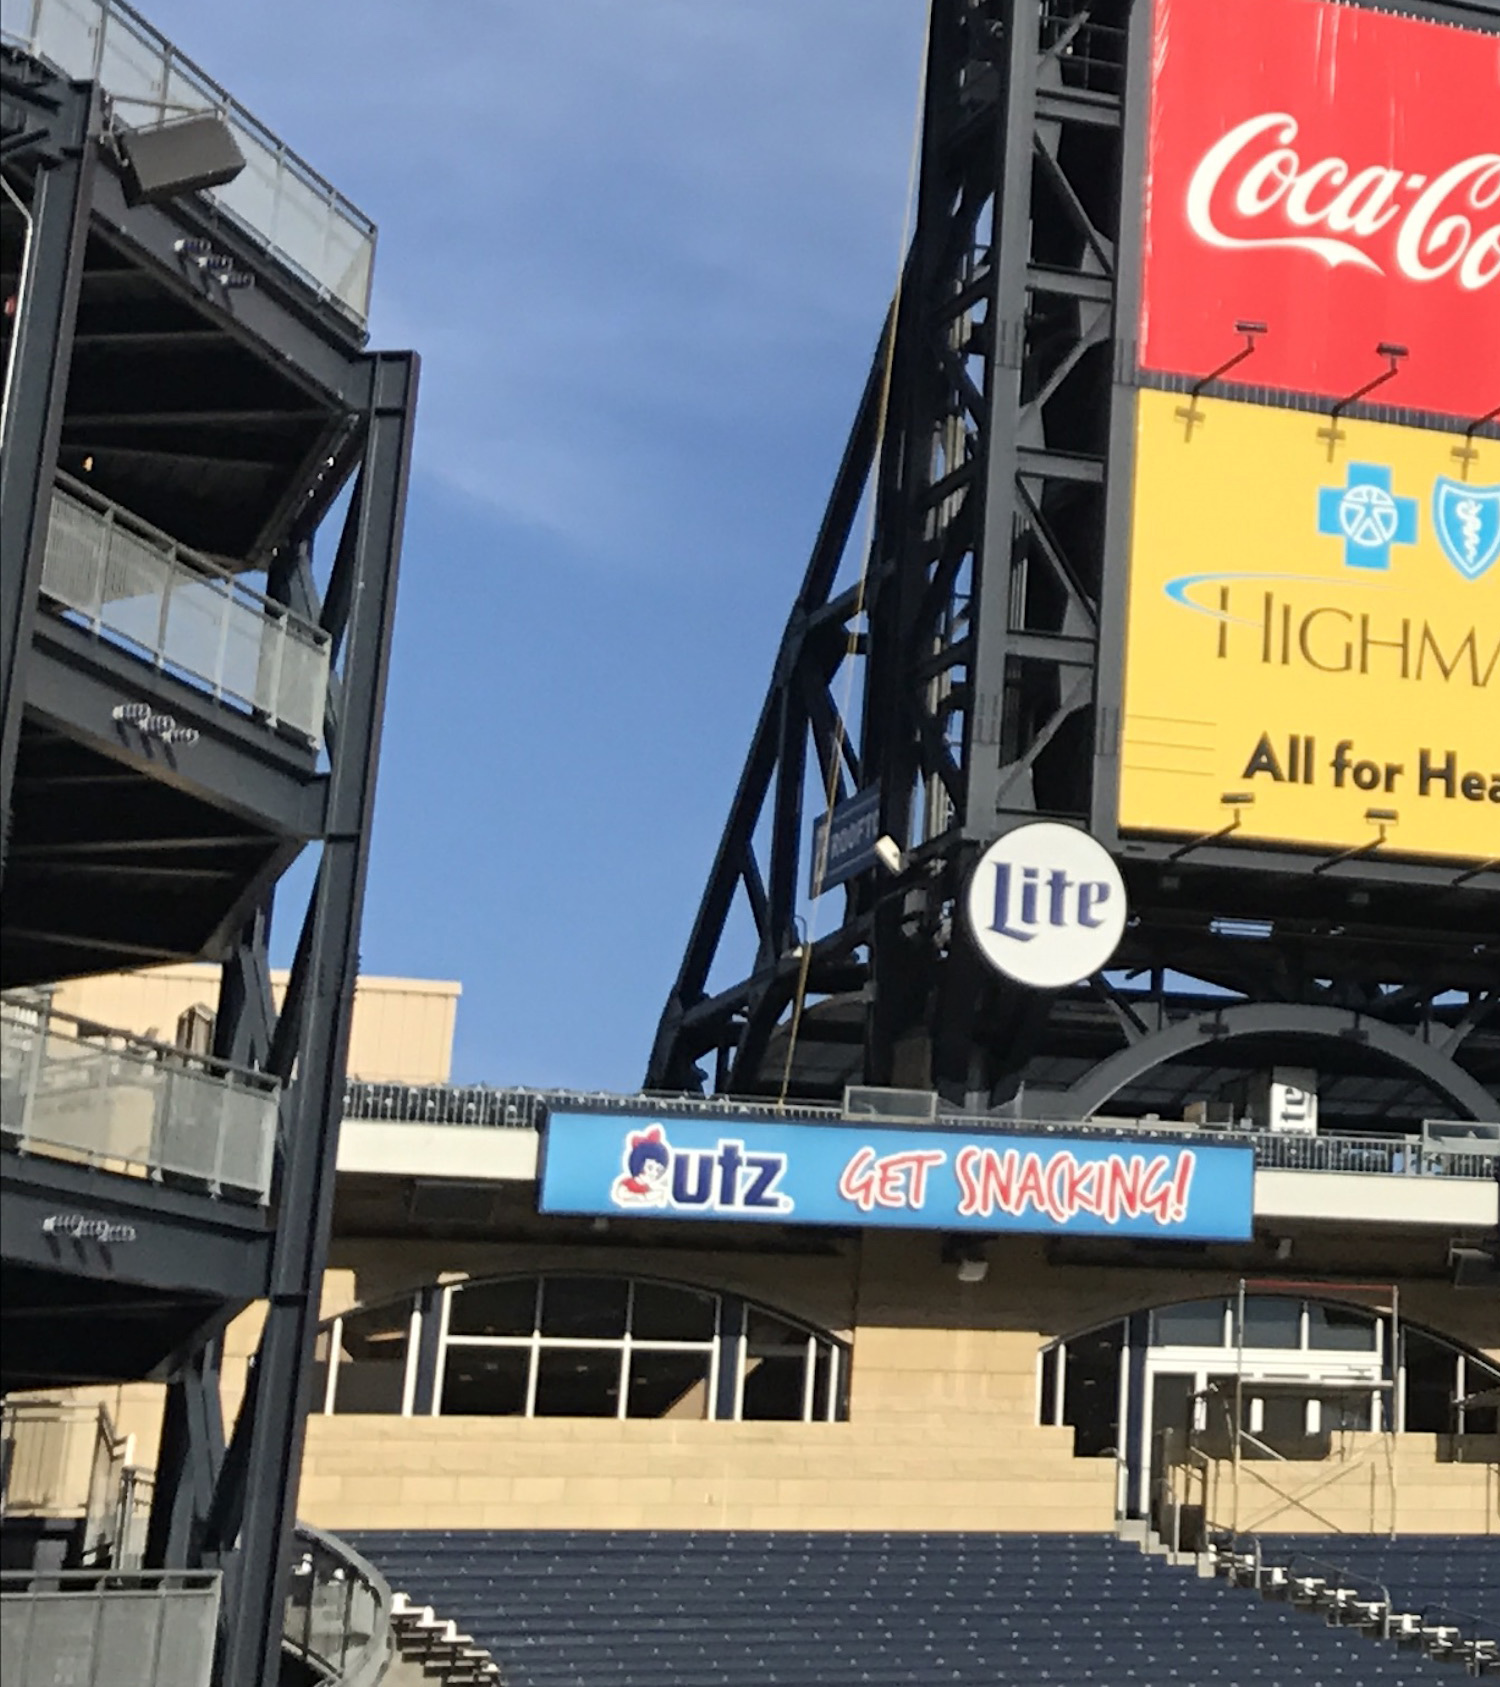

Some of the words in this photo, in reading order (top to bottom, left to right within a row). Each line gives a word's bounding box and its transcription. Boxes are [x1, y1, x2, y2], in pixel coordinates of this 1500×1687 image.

[1241, 731, 1317, 786] All
[1330, 740, 1405, 794] for
[985, 861, 1112, 943] Lite
[842, 1148, 945, 1208] GET
[956, 1145, 1197, 1224] SNACKING!
